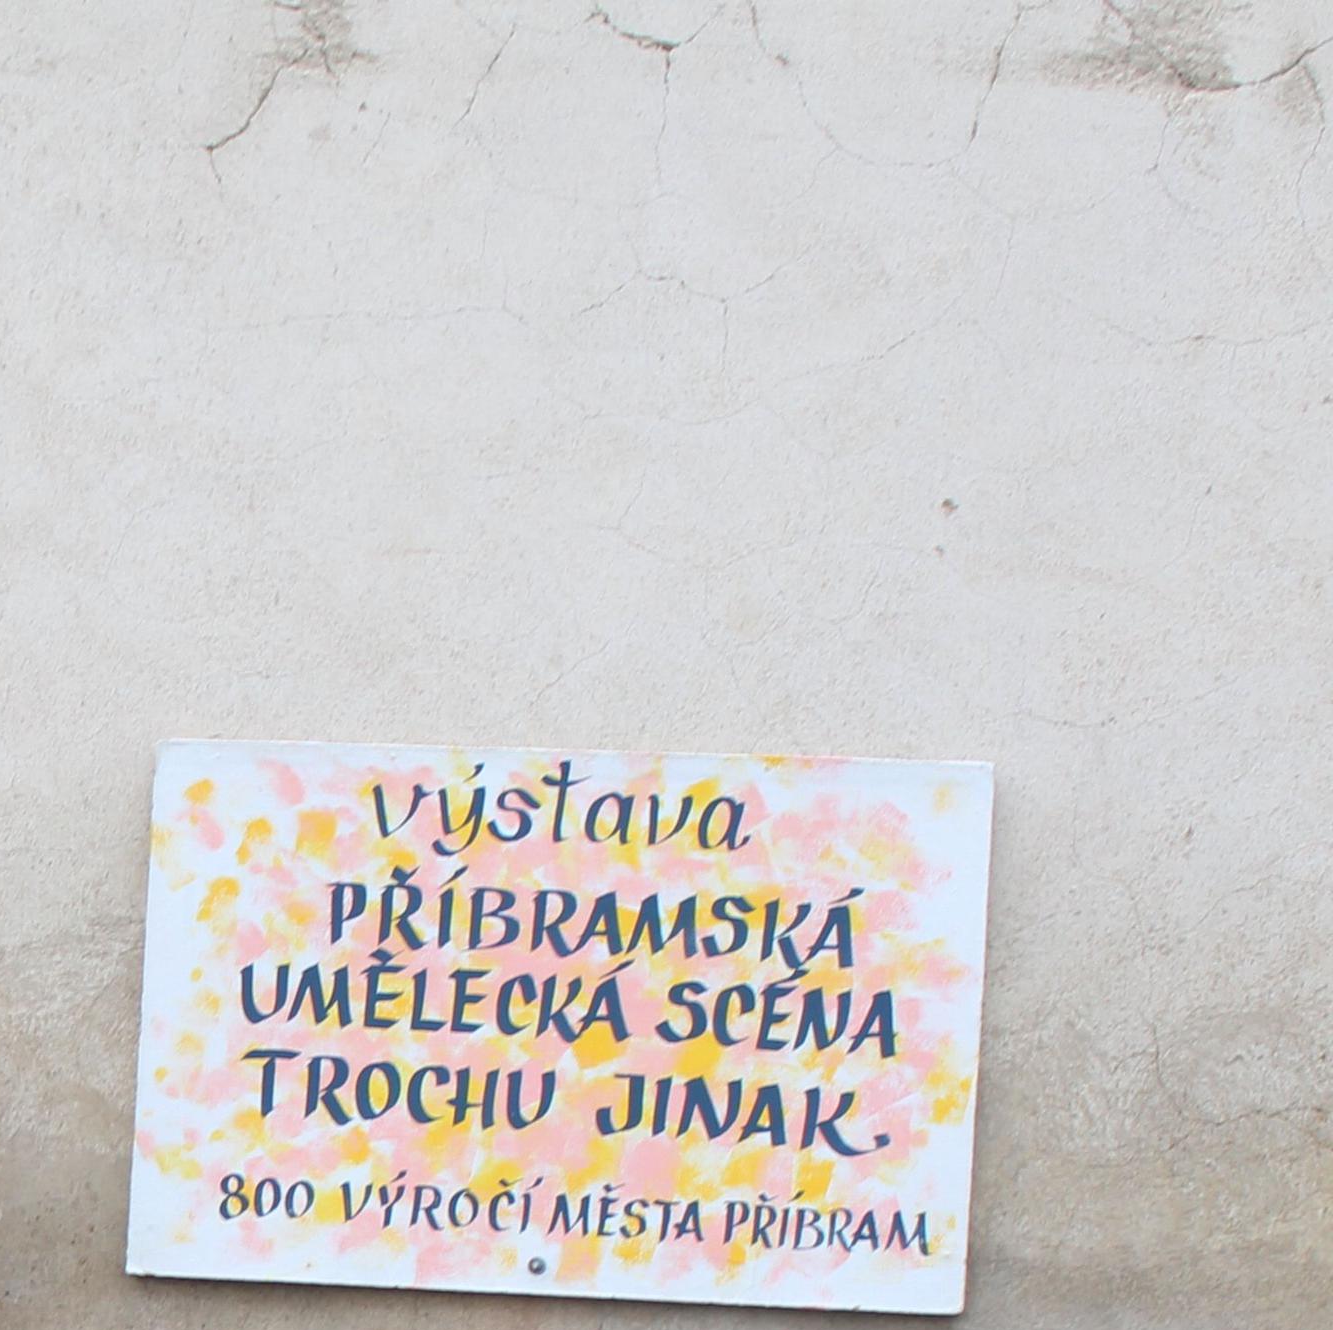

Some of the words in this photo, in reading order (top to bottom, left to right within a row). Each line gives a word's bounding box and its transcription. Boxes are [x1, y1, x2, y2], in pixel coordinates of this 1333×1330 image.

[371, 759, 755, 857] výstava
[329, 865, 865, 970] PŘÍBRAMSKÁ
[240, 949, 635, 1043] UMĚLECKÁ
[654, 968, 899, 1059] SCÉNA
[241, 1049, 556, 1132] TROCHU
[595, 1073, 891, 1157] JINAK
[218, 1173, 315, 1223] 800
[340, 1169, 545, 1234] VÝROČÍ
[547, 1183, 705, 1243] MĚSTA
[723, 1190, 932, 1258] PŘÍBRAM
